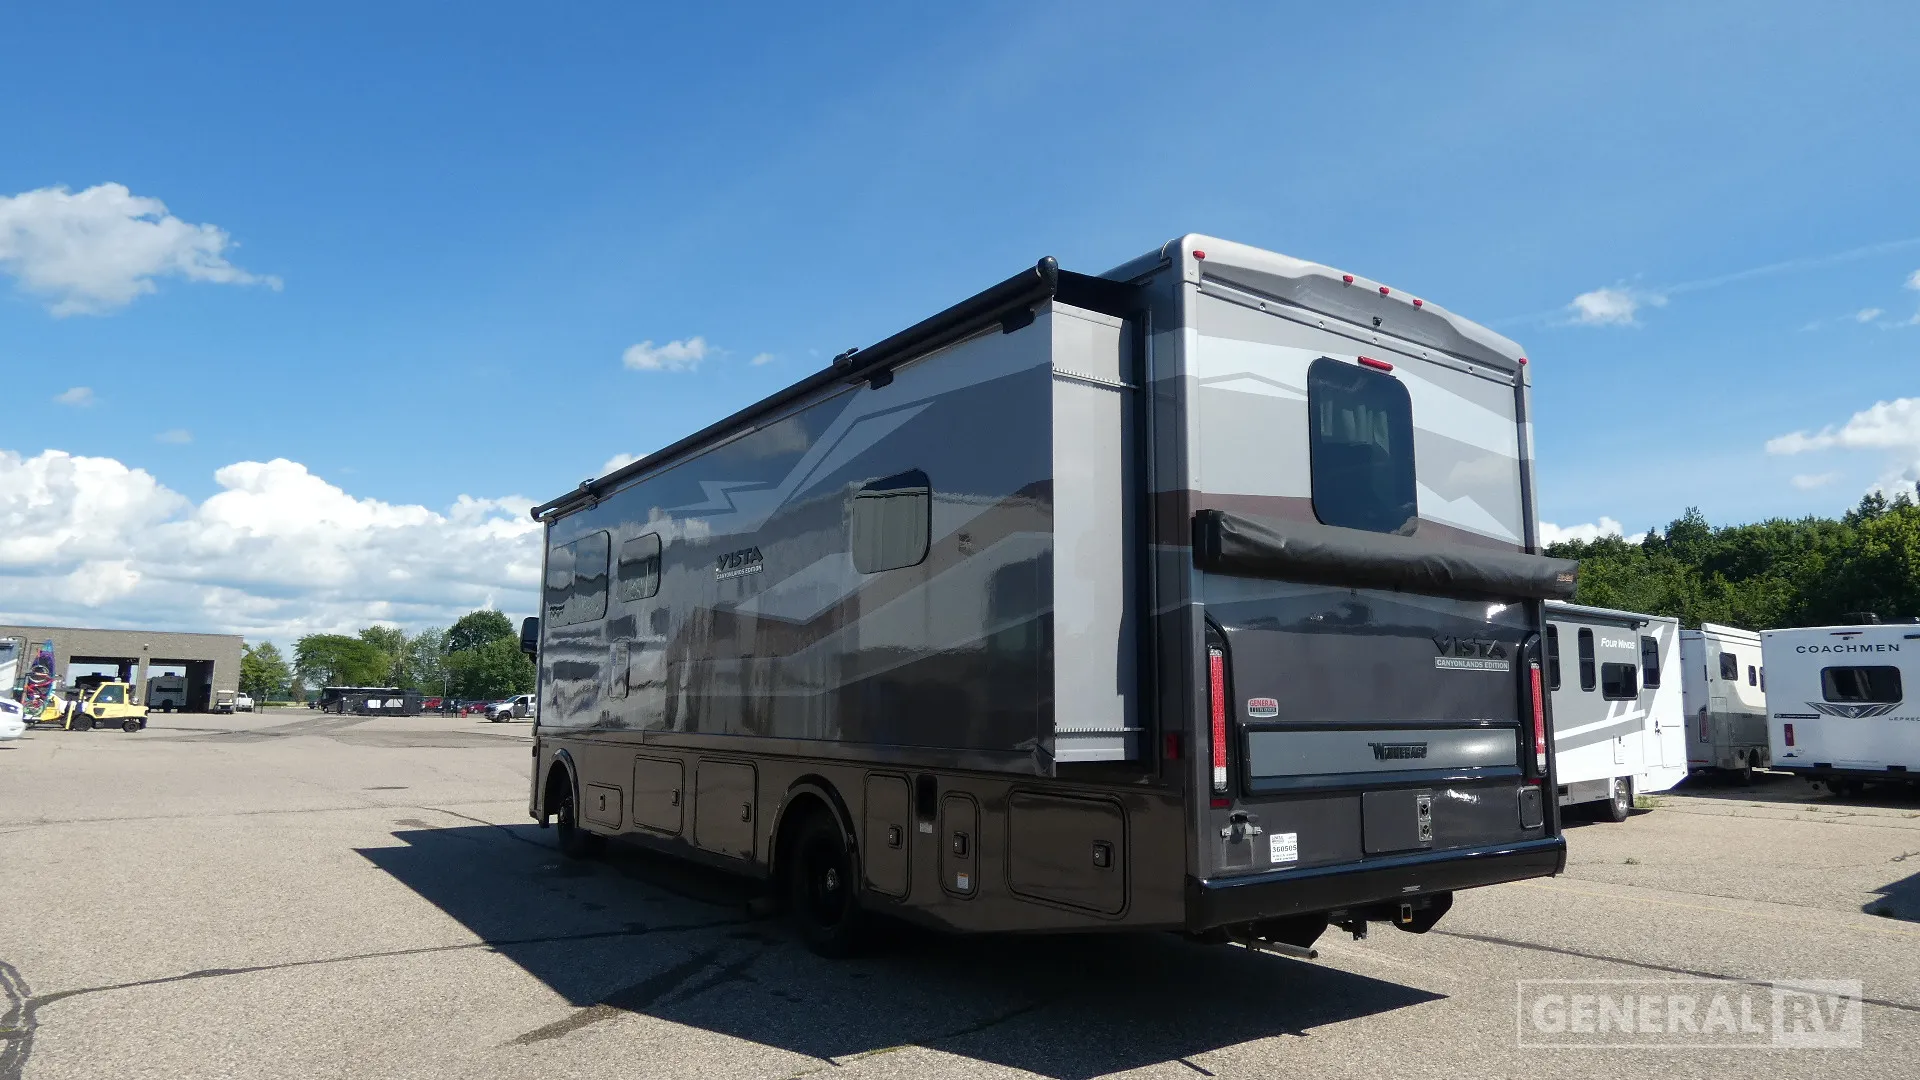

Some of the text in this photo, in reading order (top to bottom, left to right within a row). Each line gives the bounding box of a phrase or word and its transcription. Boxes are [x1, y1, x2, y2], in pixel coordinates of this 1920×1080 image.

[716, 545, 763, 570] VISTA
[1432, 635, 1508, 658] VISTA
[1796, 643, 1901, 654] COACHMEN
[1436, 659, 1508, 669] CANYONLANDS EDITION
[1250, 699, 1277, 707] GENERAL
